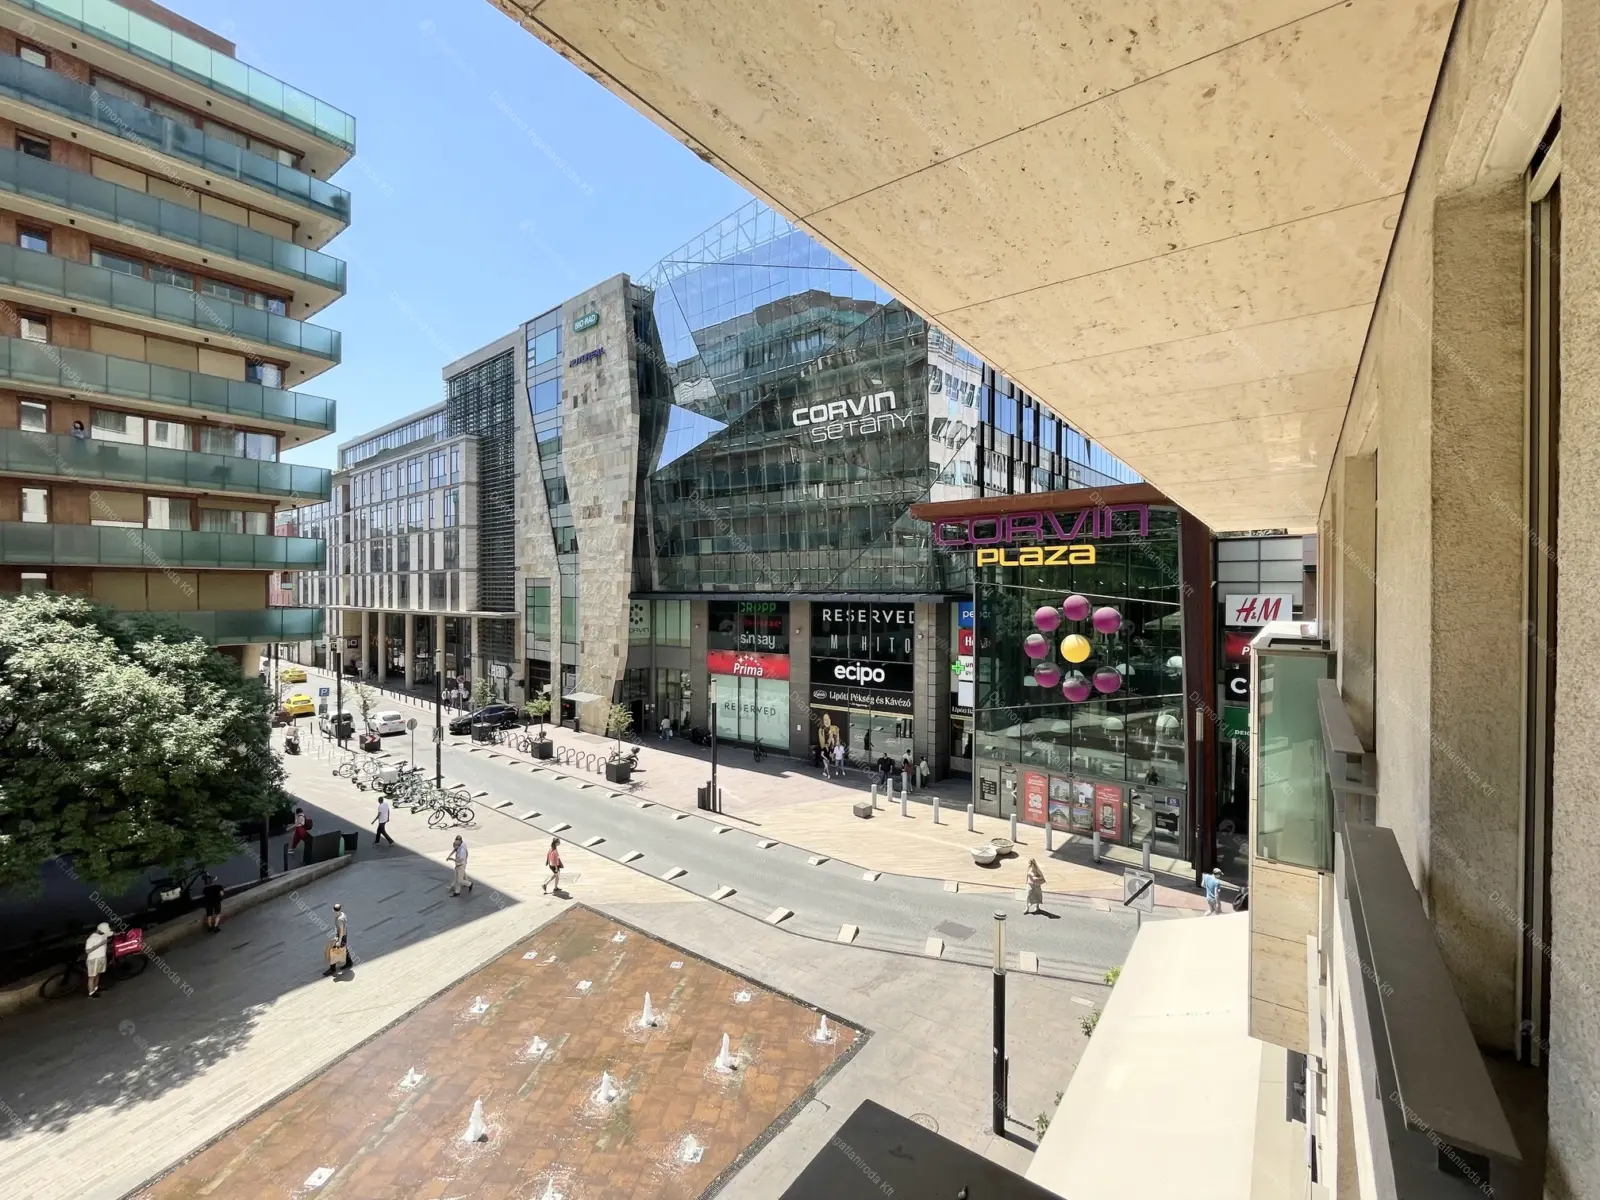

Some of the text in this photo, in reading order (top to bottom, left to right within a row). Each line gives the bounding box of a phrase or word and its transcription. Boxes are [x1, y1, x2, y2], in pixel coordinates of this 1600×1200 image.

[1235, 597, 1282, 623] H&M
[740, 630, 776, 650] sinsay
[834, 661, 885, 686] ecipo
[850, 693, 875, 705] Pékség
[875, 695, 884, 704] és
[884, 696, 912, 708] Kávézó
